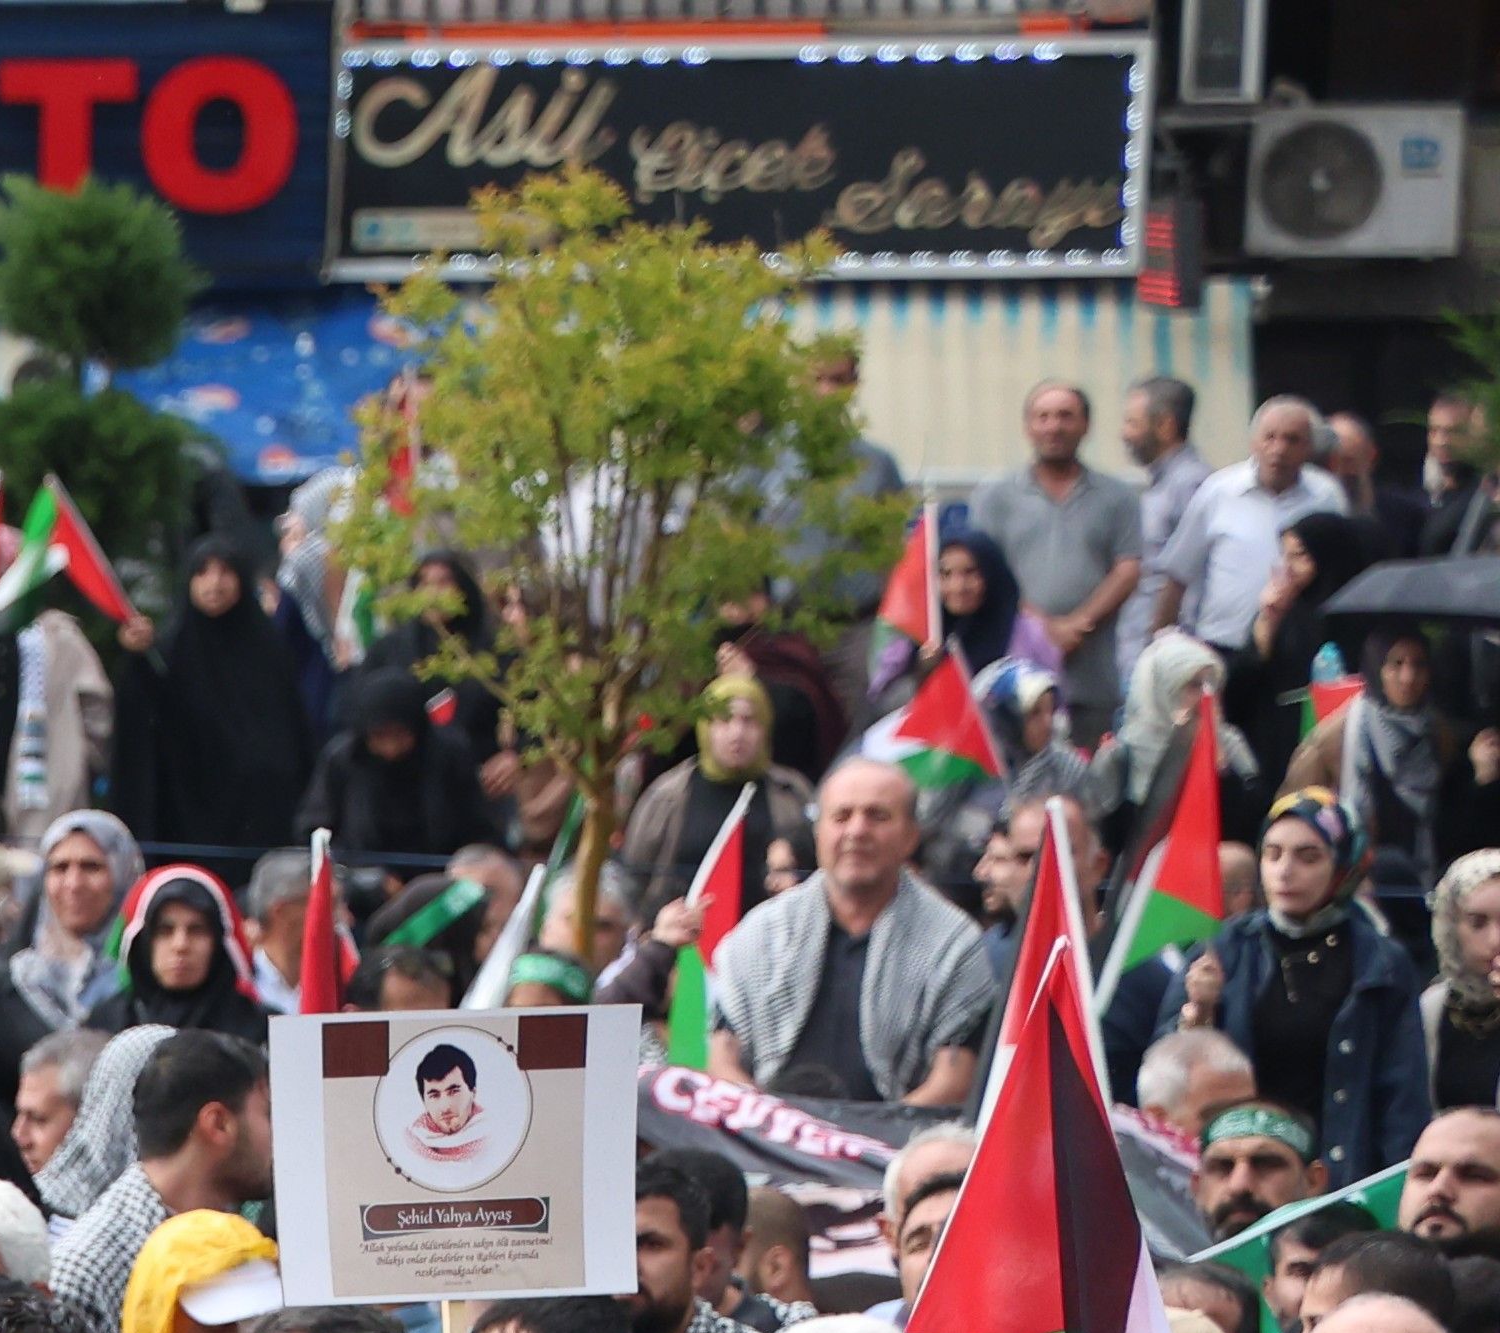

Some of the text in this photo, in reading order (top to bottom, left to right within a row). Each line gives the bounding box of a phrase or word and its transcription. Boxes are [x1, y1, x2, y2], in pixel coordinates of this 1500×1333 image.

[397, 1206, 512, 1229] Şehid Yahya Ayyaş
